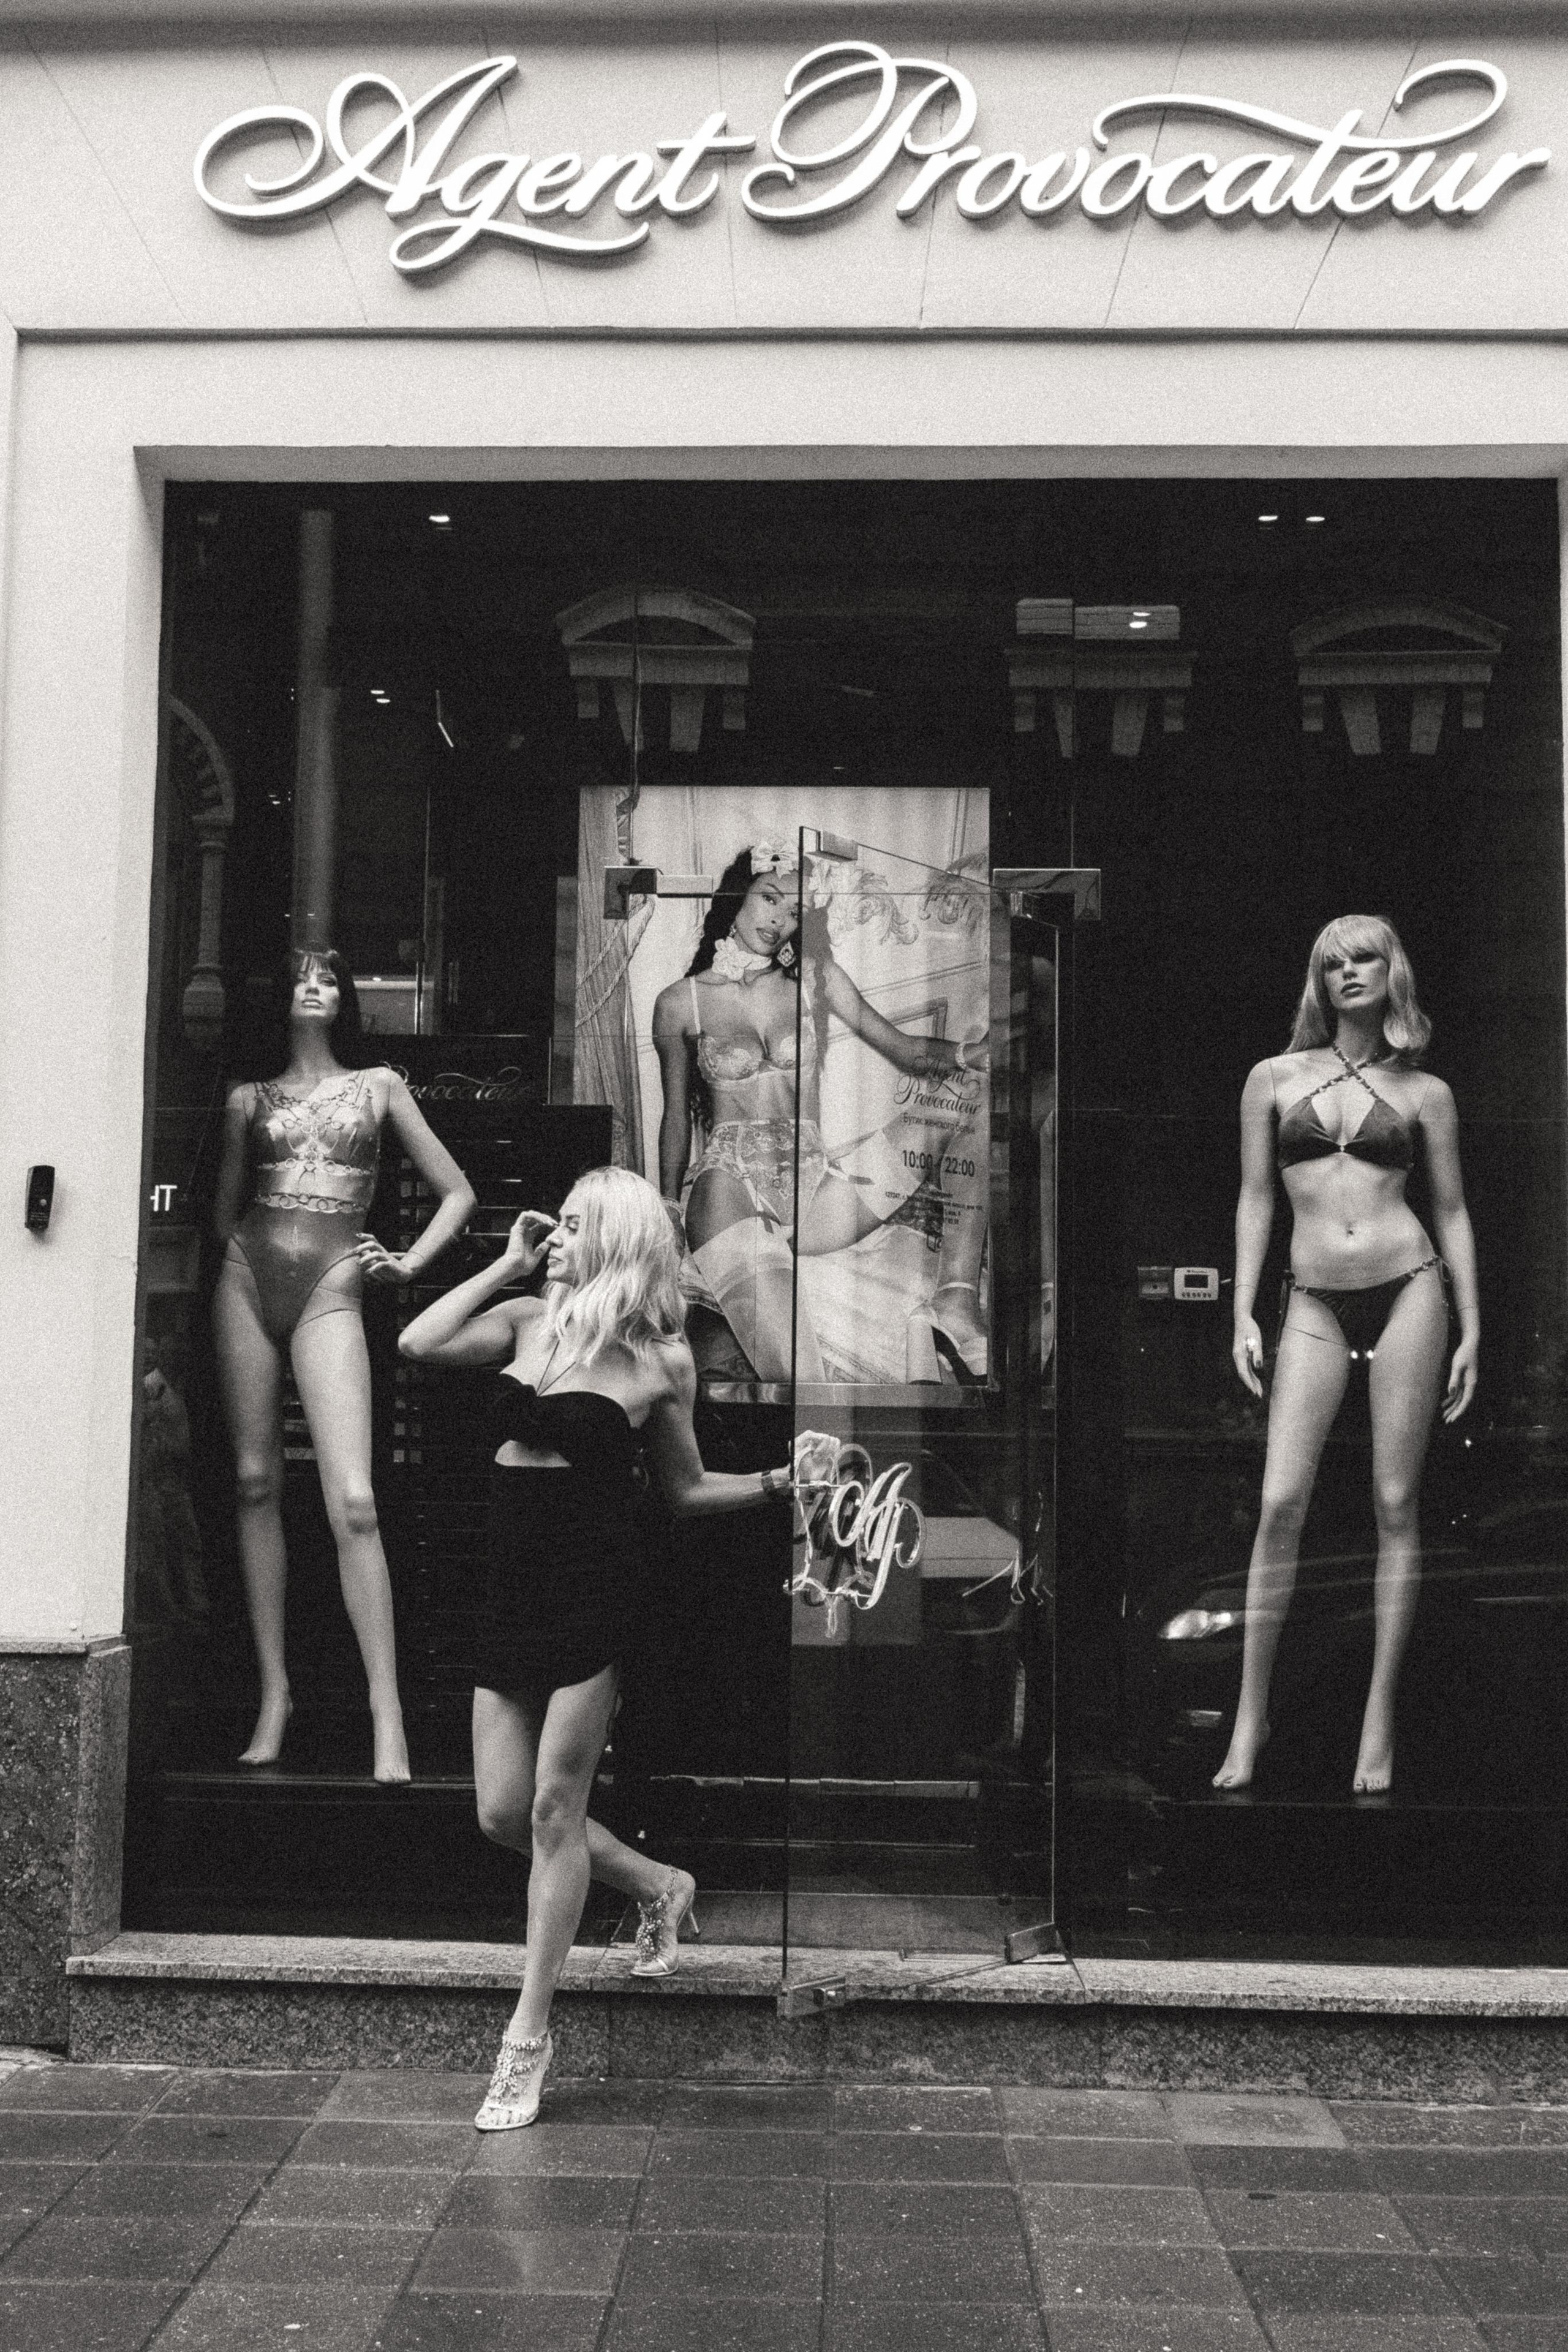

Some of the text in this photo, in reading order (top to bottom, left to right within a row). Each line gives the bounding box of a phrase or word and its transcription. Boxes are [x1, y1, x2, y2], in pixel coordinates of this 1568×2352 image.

[192, 40, 1552, 275] Agent Provocateur
[893, 1074, 981, 1115] Provocateur
[913, 1053, 976, 1095] Agent
[902, 1149, 975, 1177] 10:00 22:00
